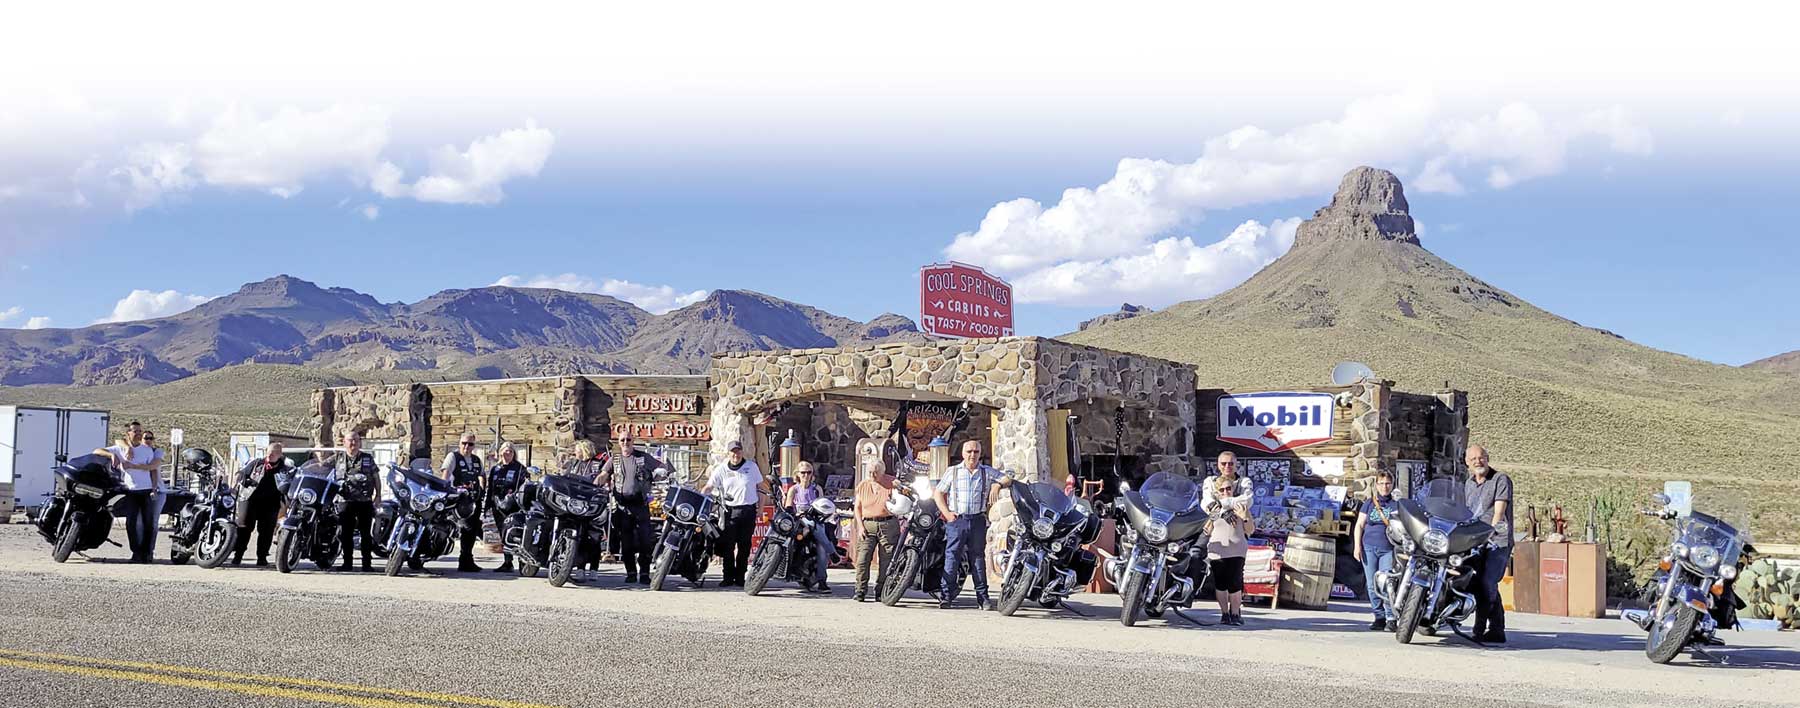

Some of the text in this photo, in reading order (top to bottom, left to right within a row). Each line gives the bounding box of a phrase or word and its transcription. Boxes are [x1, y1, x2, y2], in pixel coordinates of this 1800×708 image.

[927, 272, 1008, 305] COOL SPRINGS
[947, 300, 990, 317] CABINS
[937, 317, 999, 336] TASTY FOODS
[626, 395, 697, 411] MUSEUM
[907, 403, 953, 418] ARIZONA
[1228, 405, 1321, 426] Mobil
[664, 423, 709, 437] SHOP
